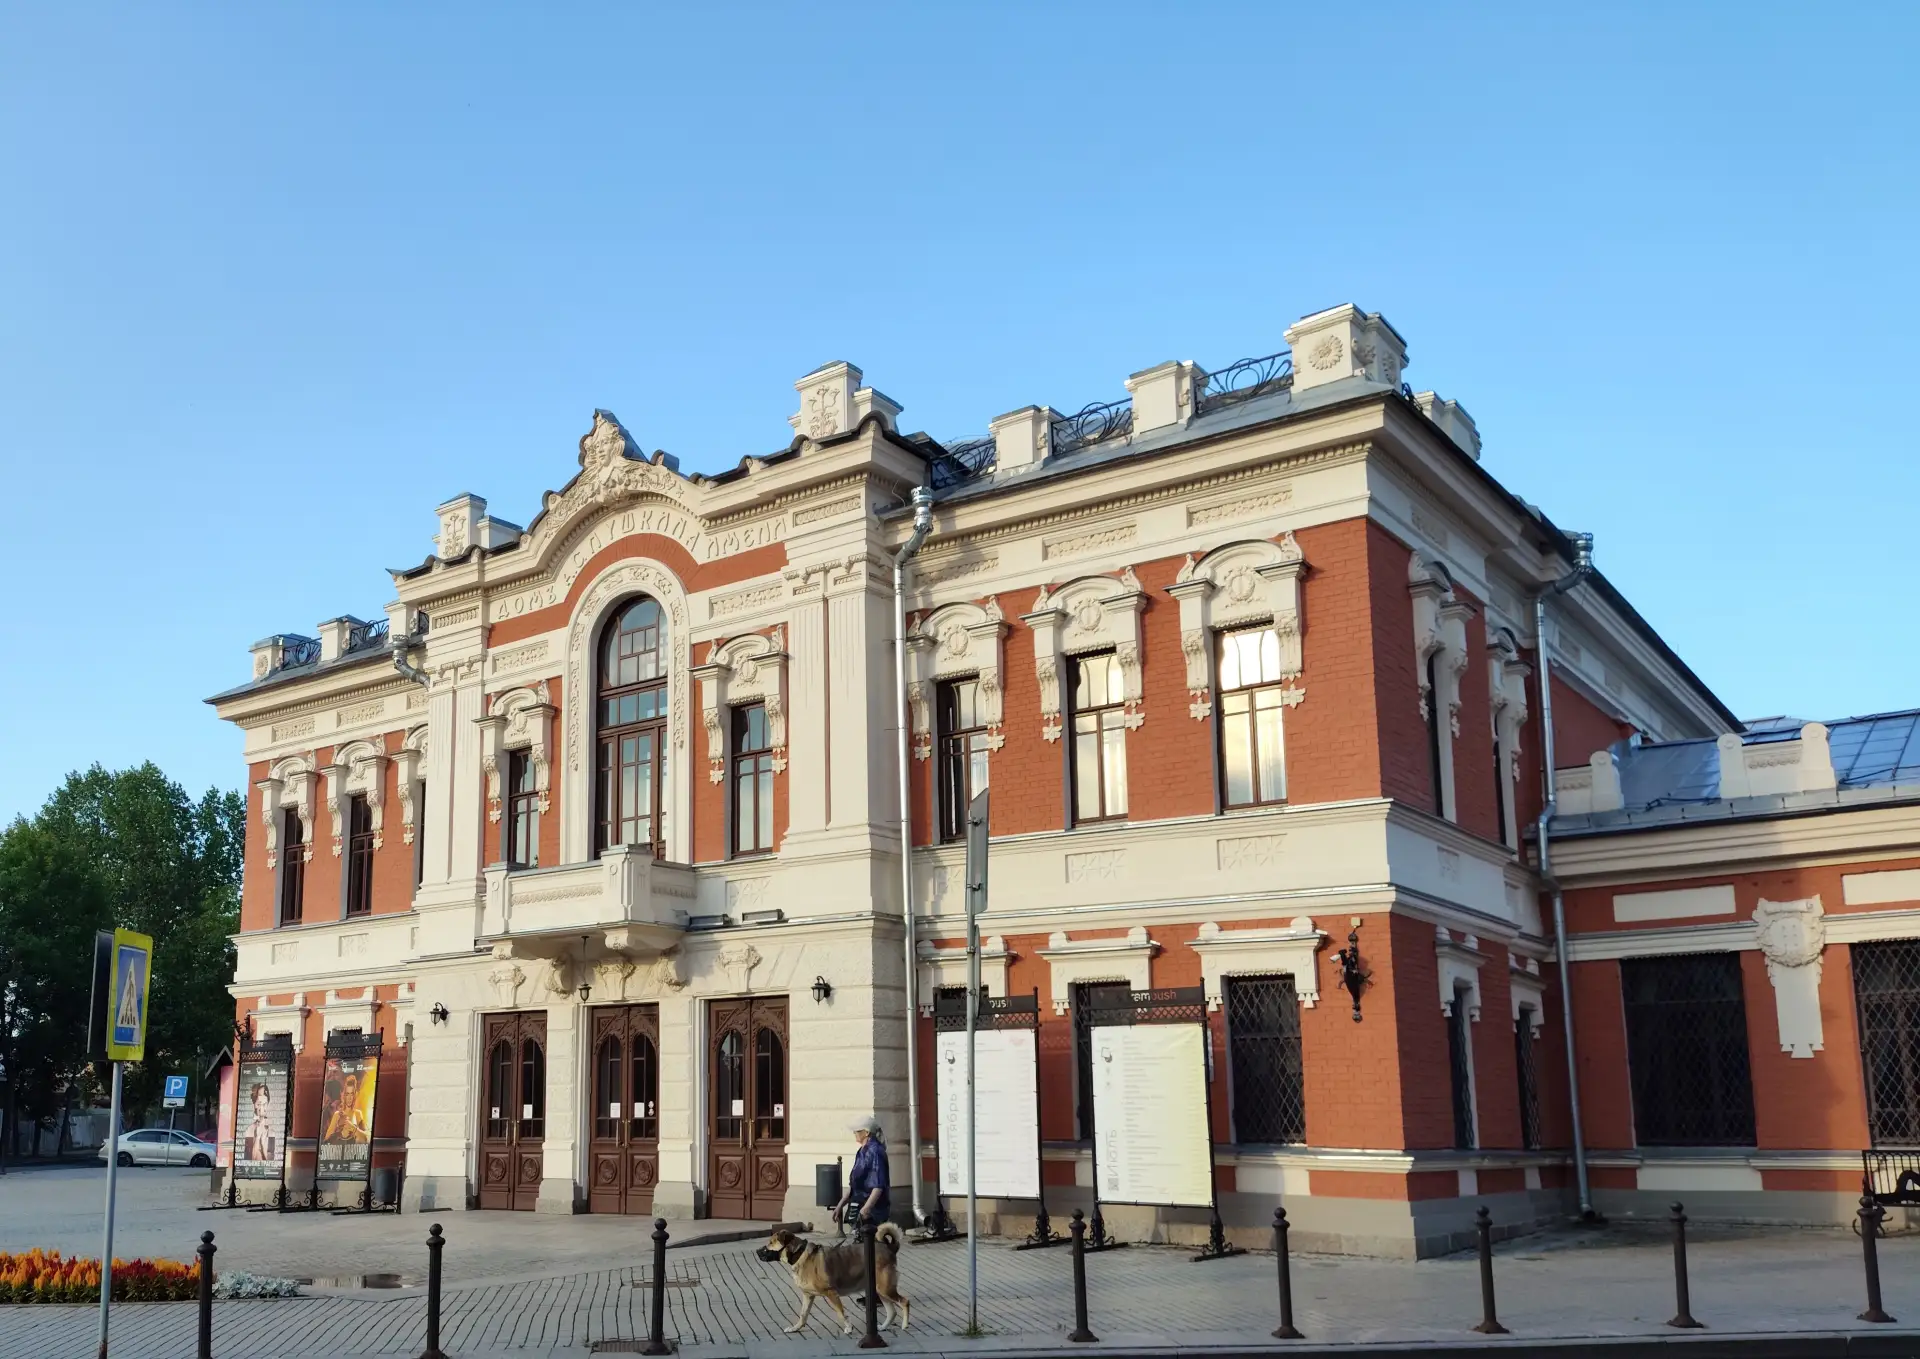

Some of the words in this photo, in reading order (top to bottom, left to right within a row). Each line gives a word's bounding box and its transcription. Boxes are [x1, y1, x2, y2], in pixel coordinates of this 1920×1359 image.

[589, 509, 701, 554] ПУШКИНА
[170, 1078, 183, 1095] P
[946, 1093, 960, 1172] Сентябрь
[1106, 1129, 1119, 1177] Июль
